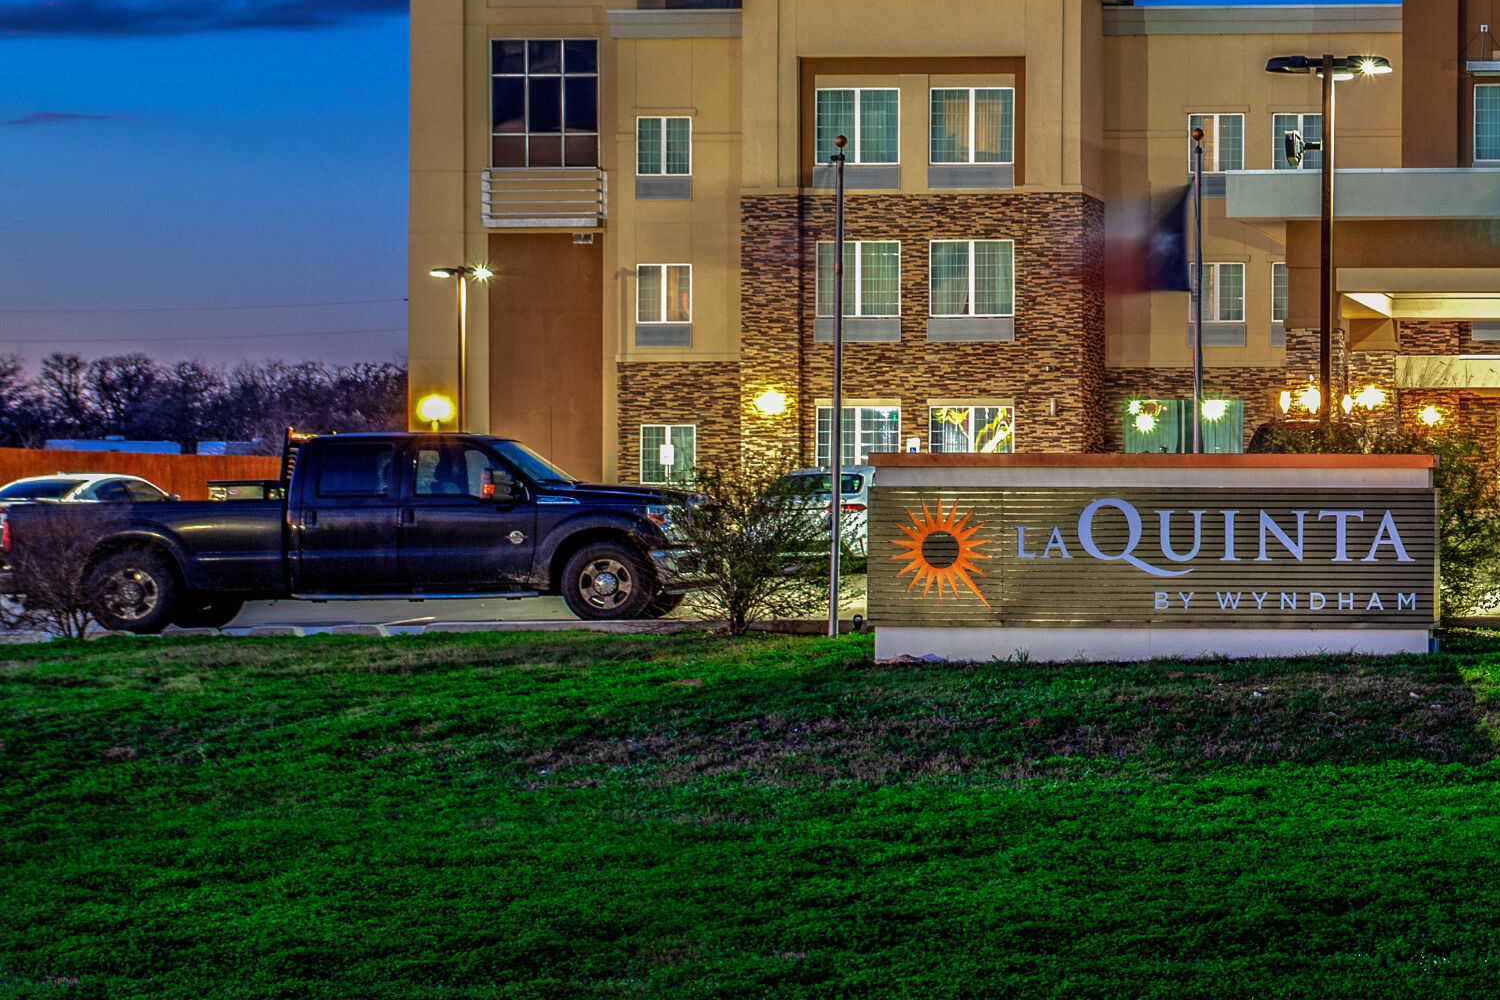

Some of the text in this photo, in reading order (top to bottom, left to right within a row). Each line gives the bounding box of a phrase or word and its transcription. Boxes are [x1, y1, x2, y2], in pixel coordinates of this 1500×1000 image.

[1014, 497, 1417, 577] LA QUINTA
[1154, 591, 1417, 611] BY WYNDHAM
